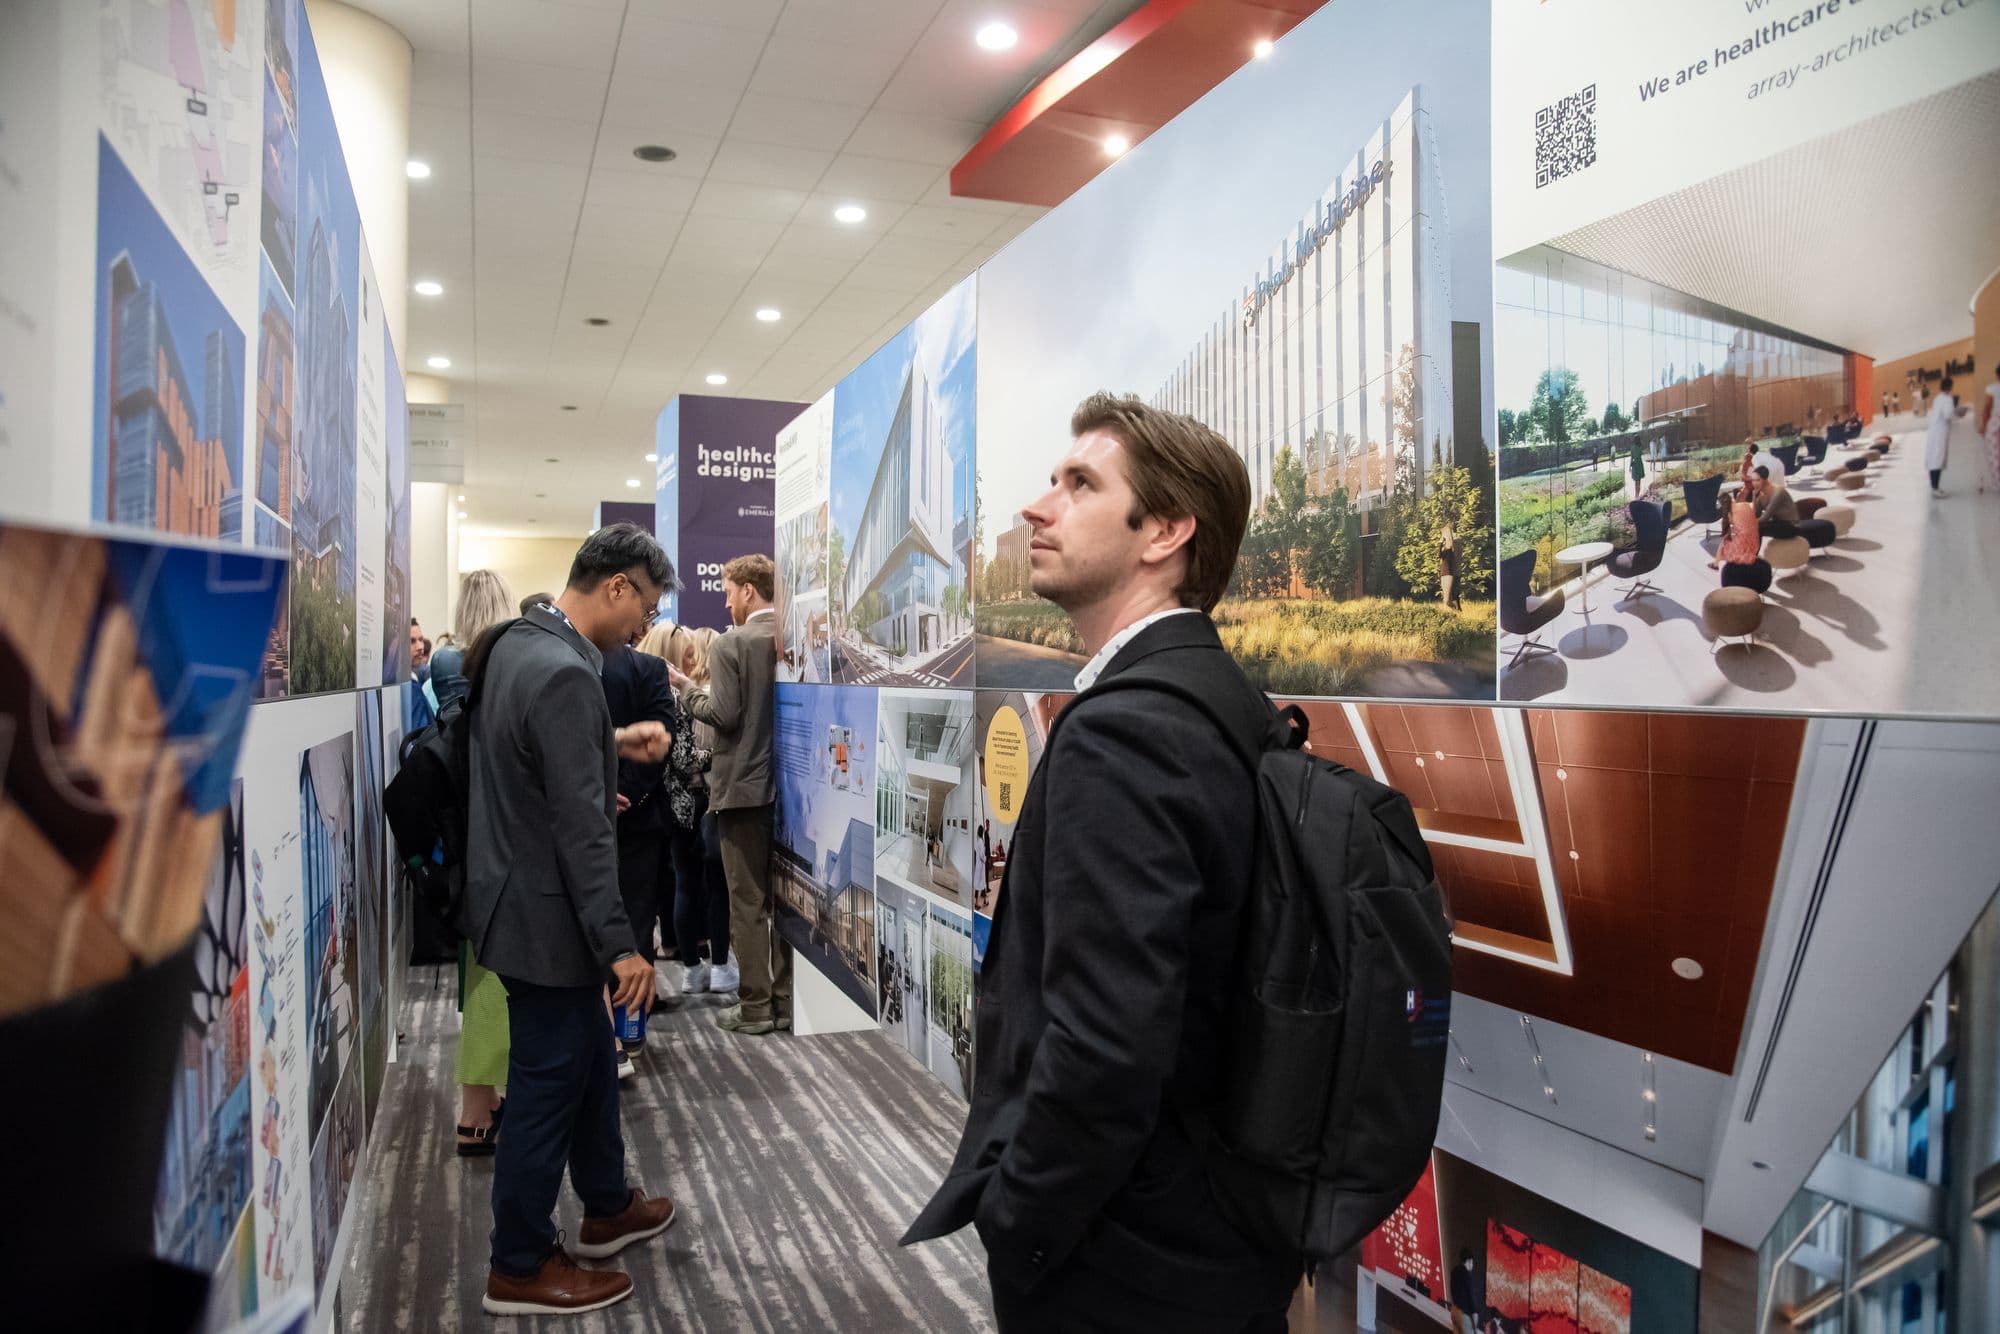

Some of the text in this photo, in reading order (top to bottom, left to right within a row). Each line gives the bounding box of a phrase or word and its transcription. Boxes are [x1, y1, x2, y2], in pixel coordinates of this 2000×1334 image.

[1639, 77, 1670, 102] We
[1676, 59, 1708, 86] are
[1715, 0, 1841, 68] healthcare
[698, 443, 776, 464] healthc
